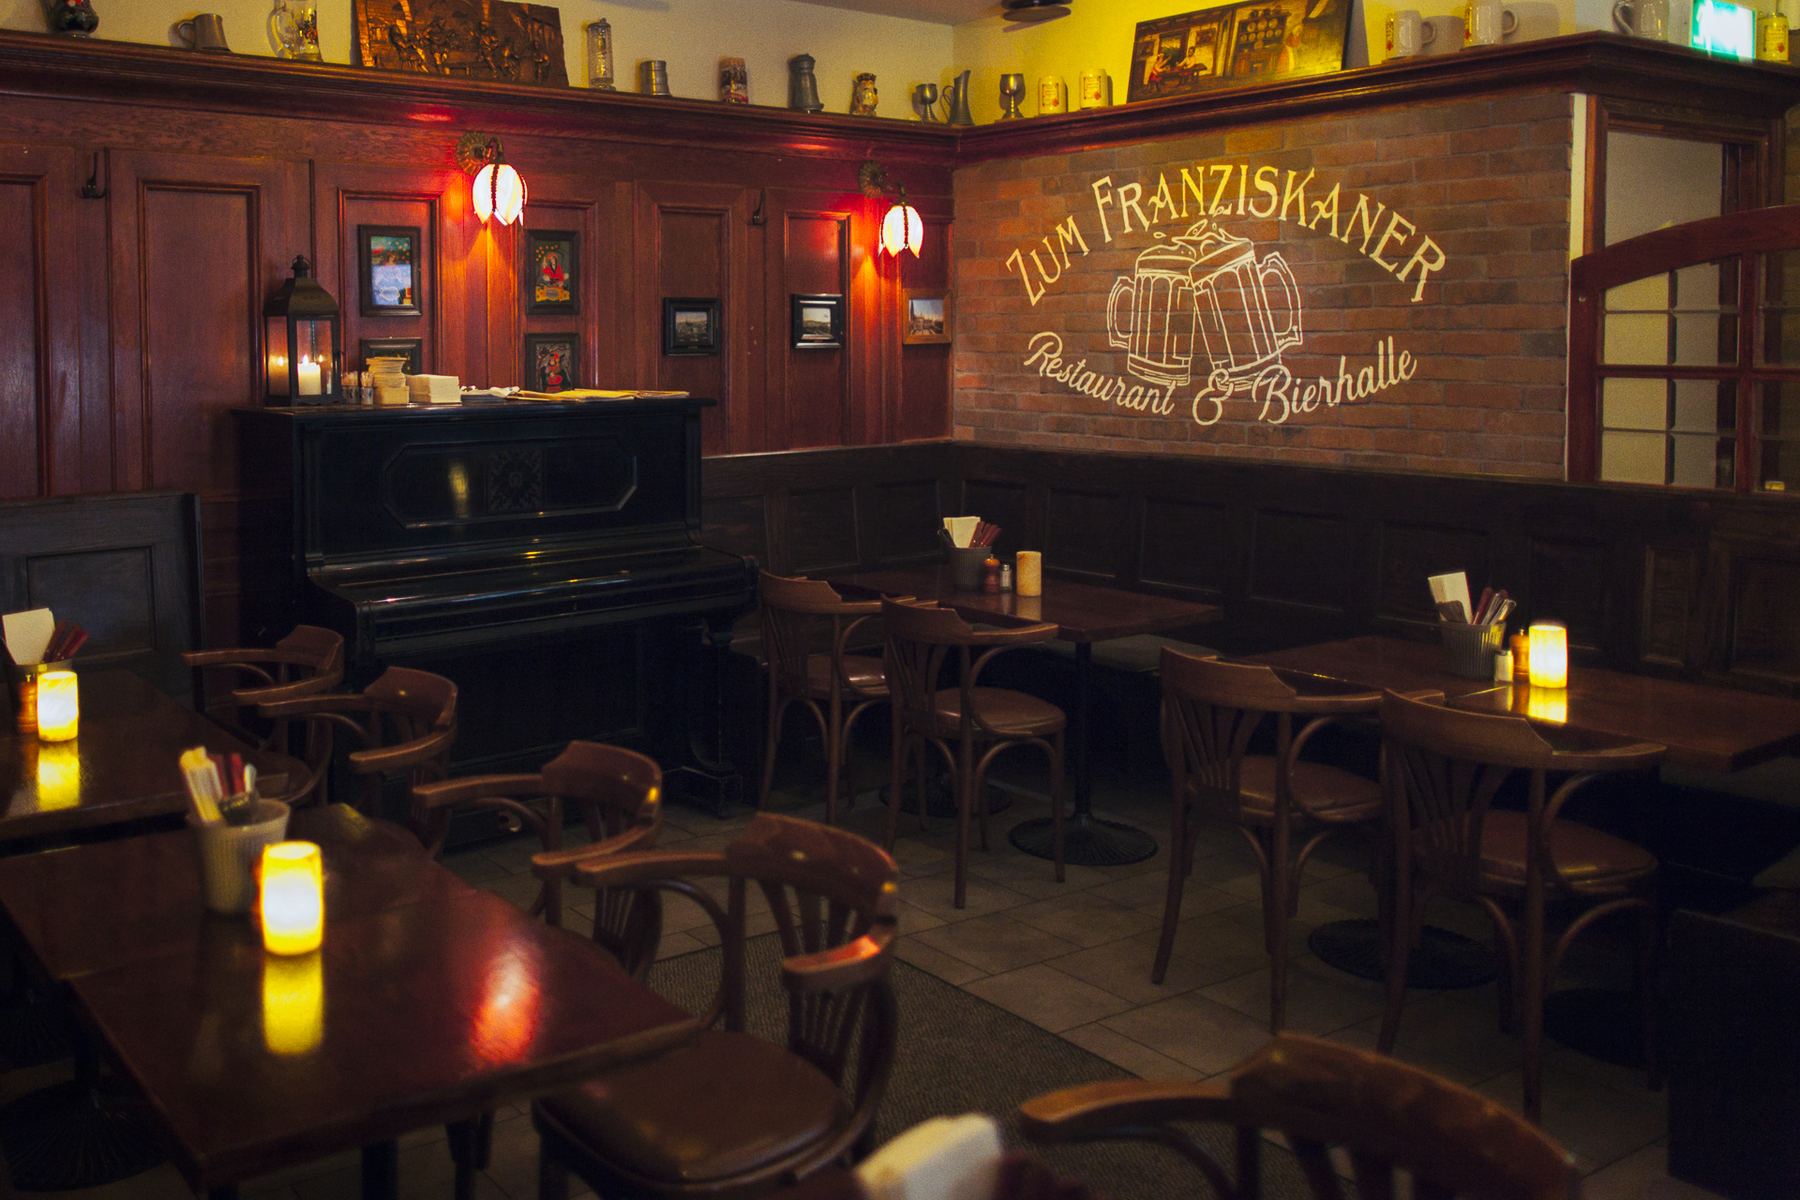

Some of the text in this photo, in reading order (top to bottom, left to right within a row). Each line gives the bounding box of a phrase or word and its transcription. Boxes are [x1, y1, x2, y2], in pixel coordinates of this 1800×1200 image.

[1005, 164, 1446, 305] ZUM FRANZISKANER
[1023, 331, 1417, 426] Restaurant & Bierhalle
